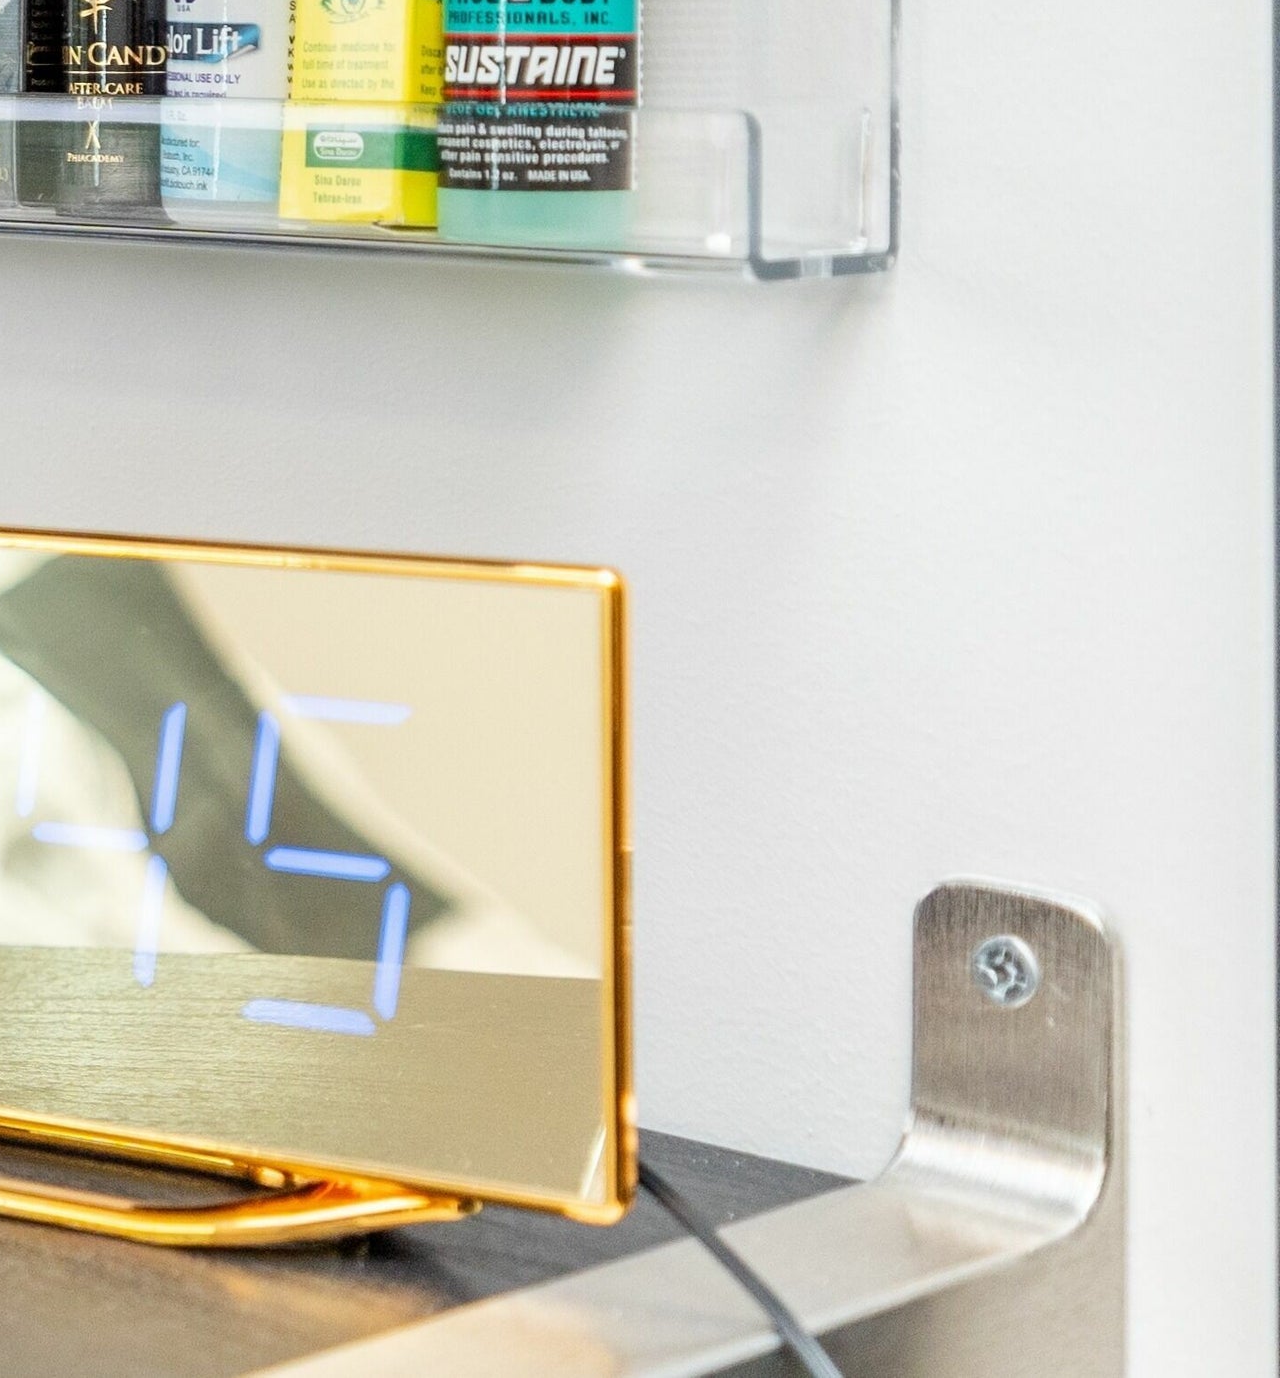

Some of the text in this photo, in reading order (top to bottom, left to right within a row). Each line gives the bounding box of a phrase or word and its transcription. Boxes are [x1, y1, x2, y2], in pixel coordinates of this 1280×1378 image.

[196, 25, 242, 55] Lift
[88, 41, 170, 66] CAND
[195, 73, 212, 83] USE
[69, 82, 144, 95] AFTER CARE
[489, 124, 542, 139] swelling
[545, 124, 585, 139] during
[527, 169, 557, 181] MADE
